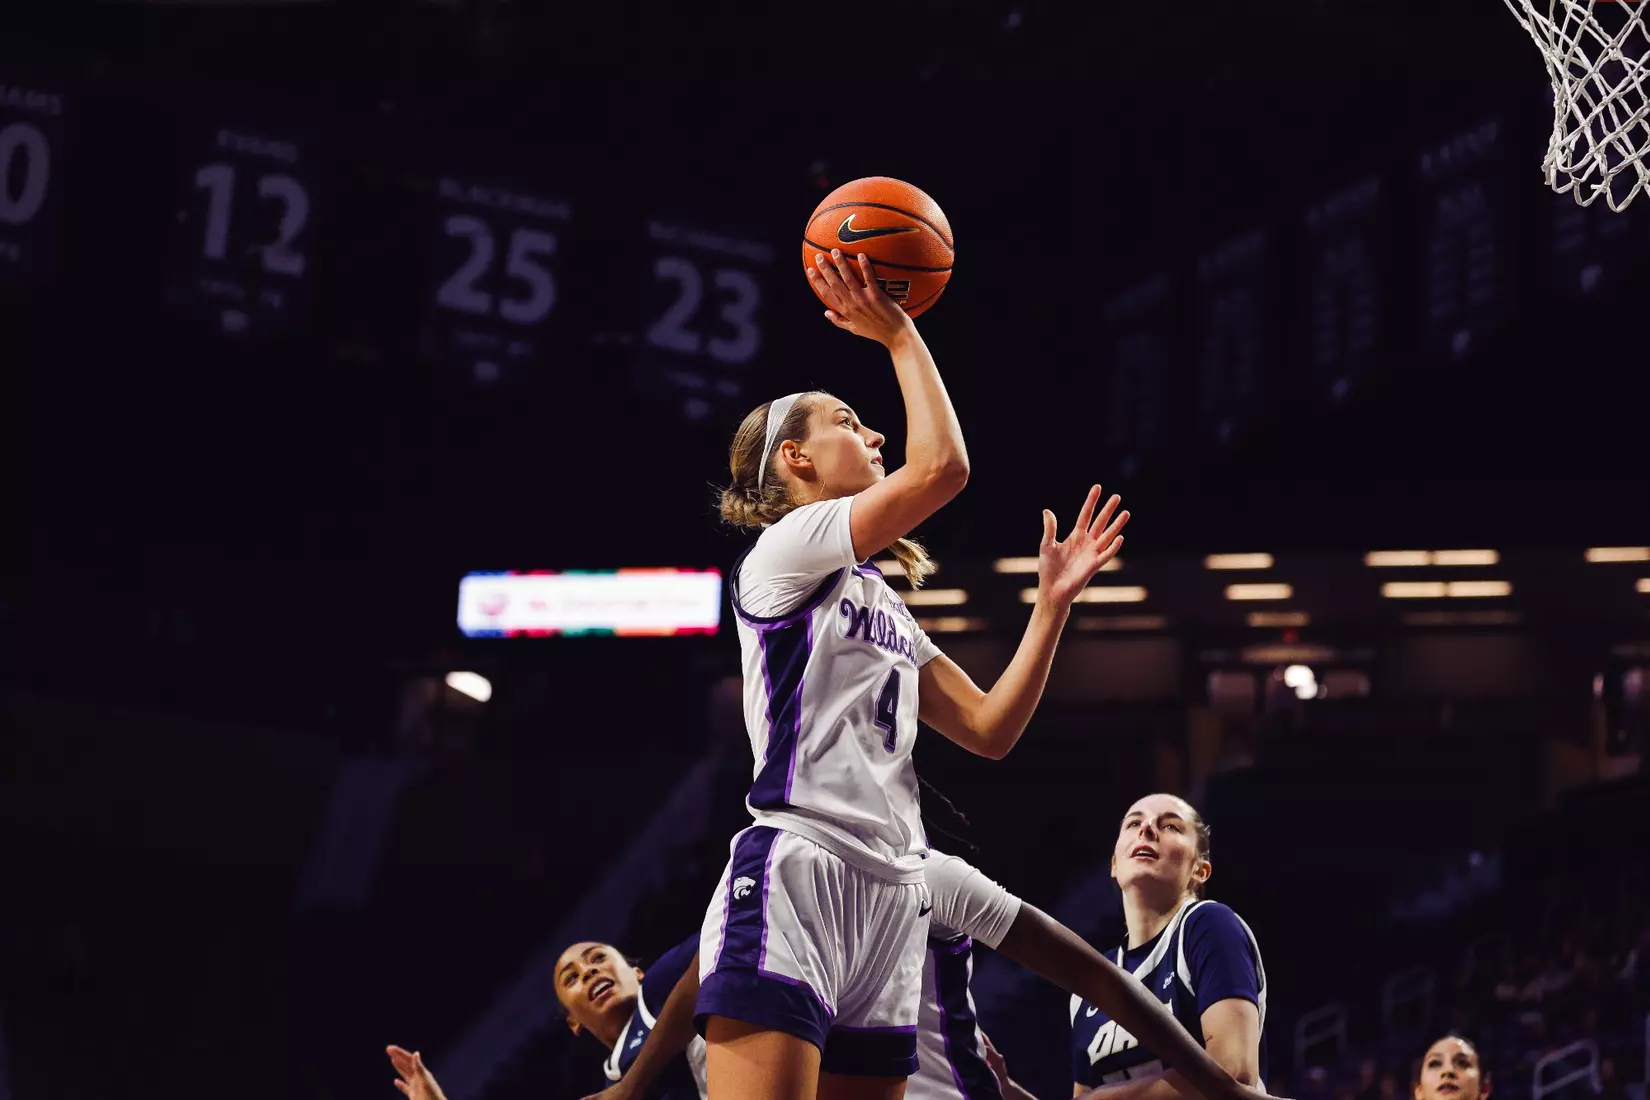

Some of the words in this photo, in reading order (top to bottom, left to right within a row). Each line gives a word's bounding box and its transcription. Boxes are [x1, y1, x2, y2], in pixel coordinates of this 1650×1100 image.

[193, 161, 311, 279] 12
[436, 211, 558, 325] 25
[645, 254, 762, 365] 23
[874, 665, 901, 754] 4
